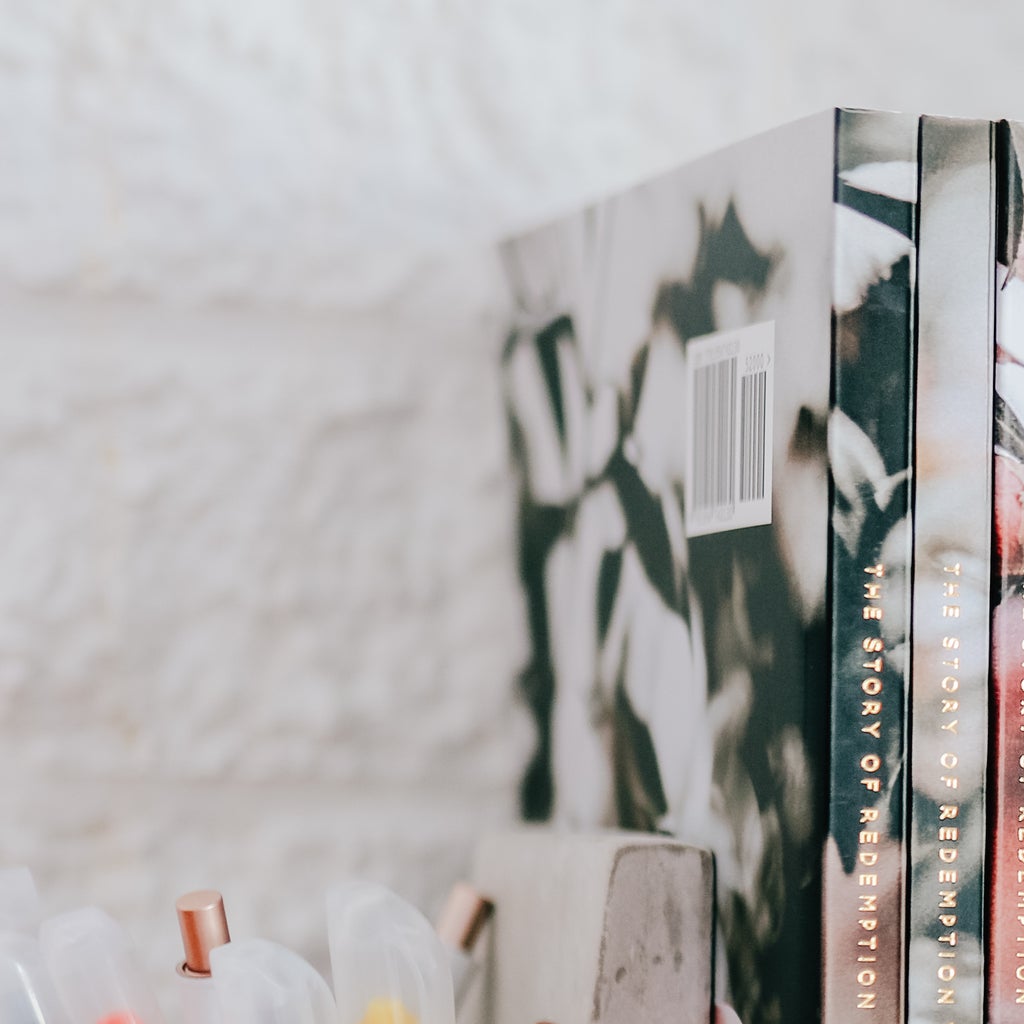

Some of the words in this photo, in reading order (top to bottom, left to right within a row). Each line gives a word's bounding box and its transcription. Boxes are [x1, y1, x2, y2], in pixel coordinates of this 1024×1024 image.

[862, 563, 886, 621] THE
[942, 562, 961, 619] THE
[861, 636, 885, 739] STORY
[940, 635, 960, 736] STORY
[860, 753, 882, 793] OF
[940, 752, 959, 790] OF
[856, 806, 880, 1010] REDEMPTION
[937, 804, 959, 1005] REDEMPTION
